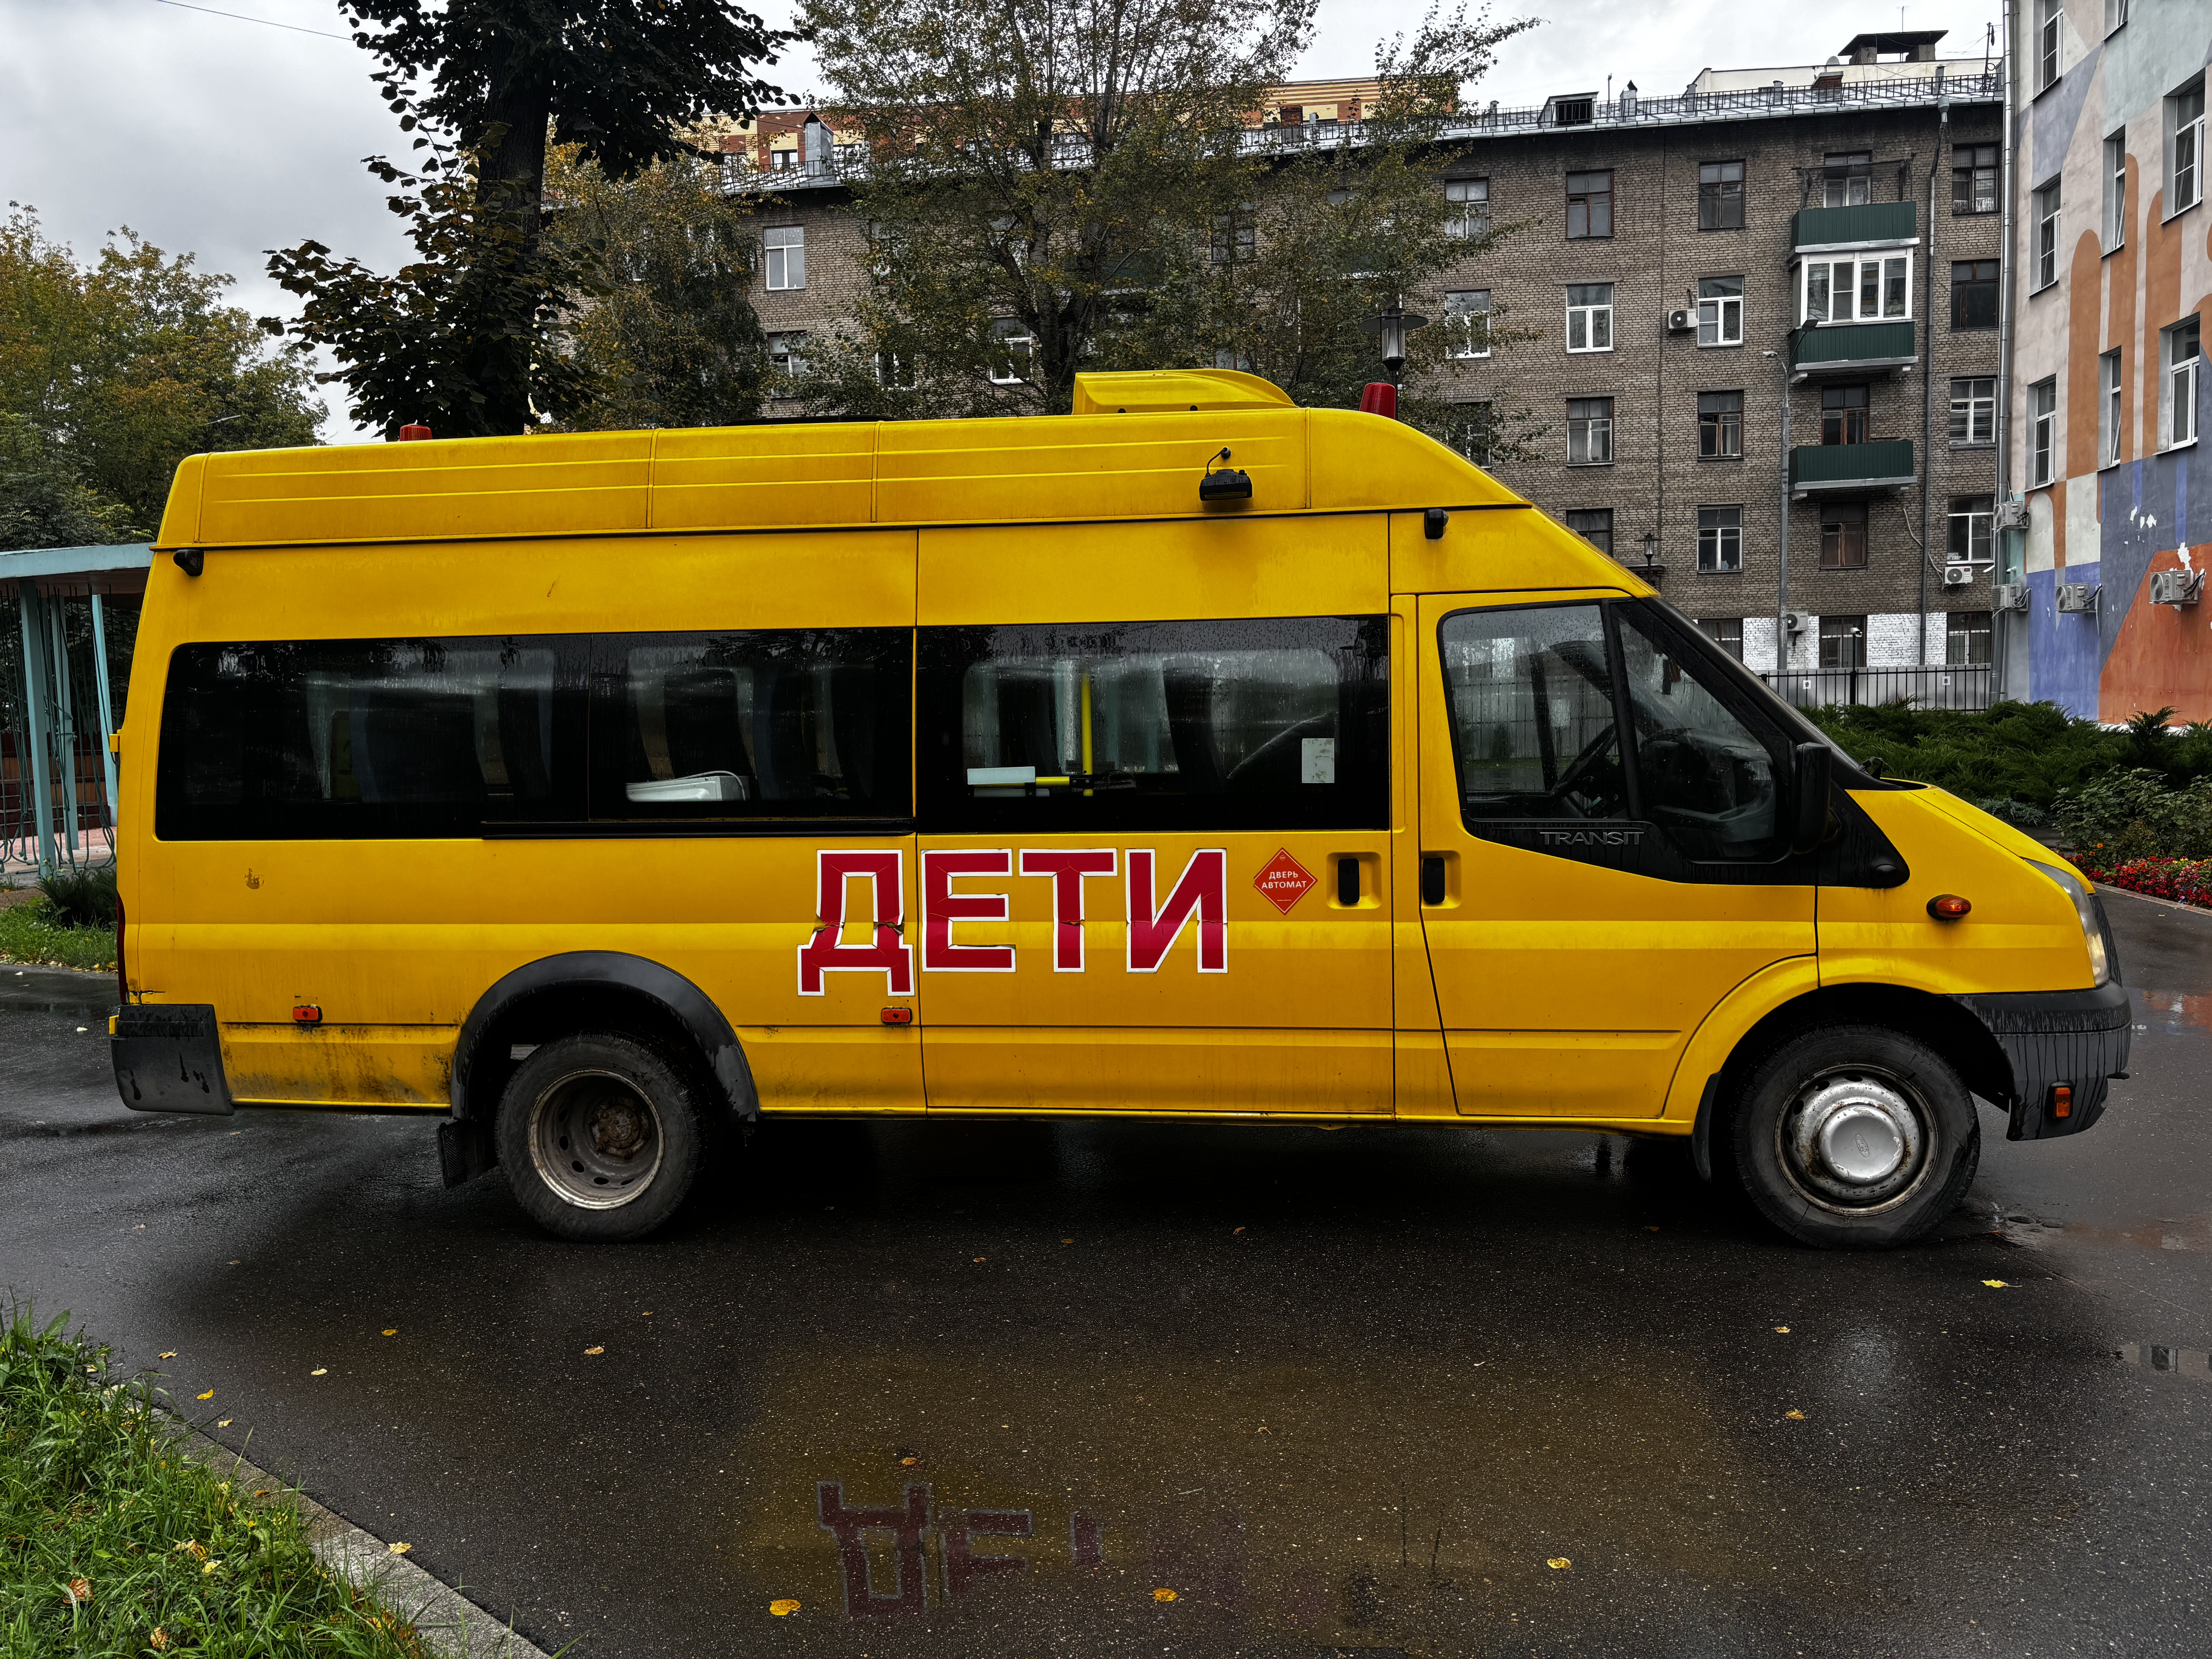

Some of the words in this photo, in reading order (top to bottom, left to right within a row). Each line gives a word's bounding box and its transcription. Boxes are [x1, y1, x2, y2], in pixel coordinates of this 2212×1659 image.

[1539, 831, 1644, 845] TRANSIT
[1269, 871, 1298, 880] ДВЕРЬ
[1261, 881, 1307, 889] АВТОМАТ
[797, 848, 1228, 996] ДЕТИ
